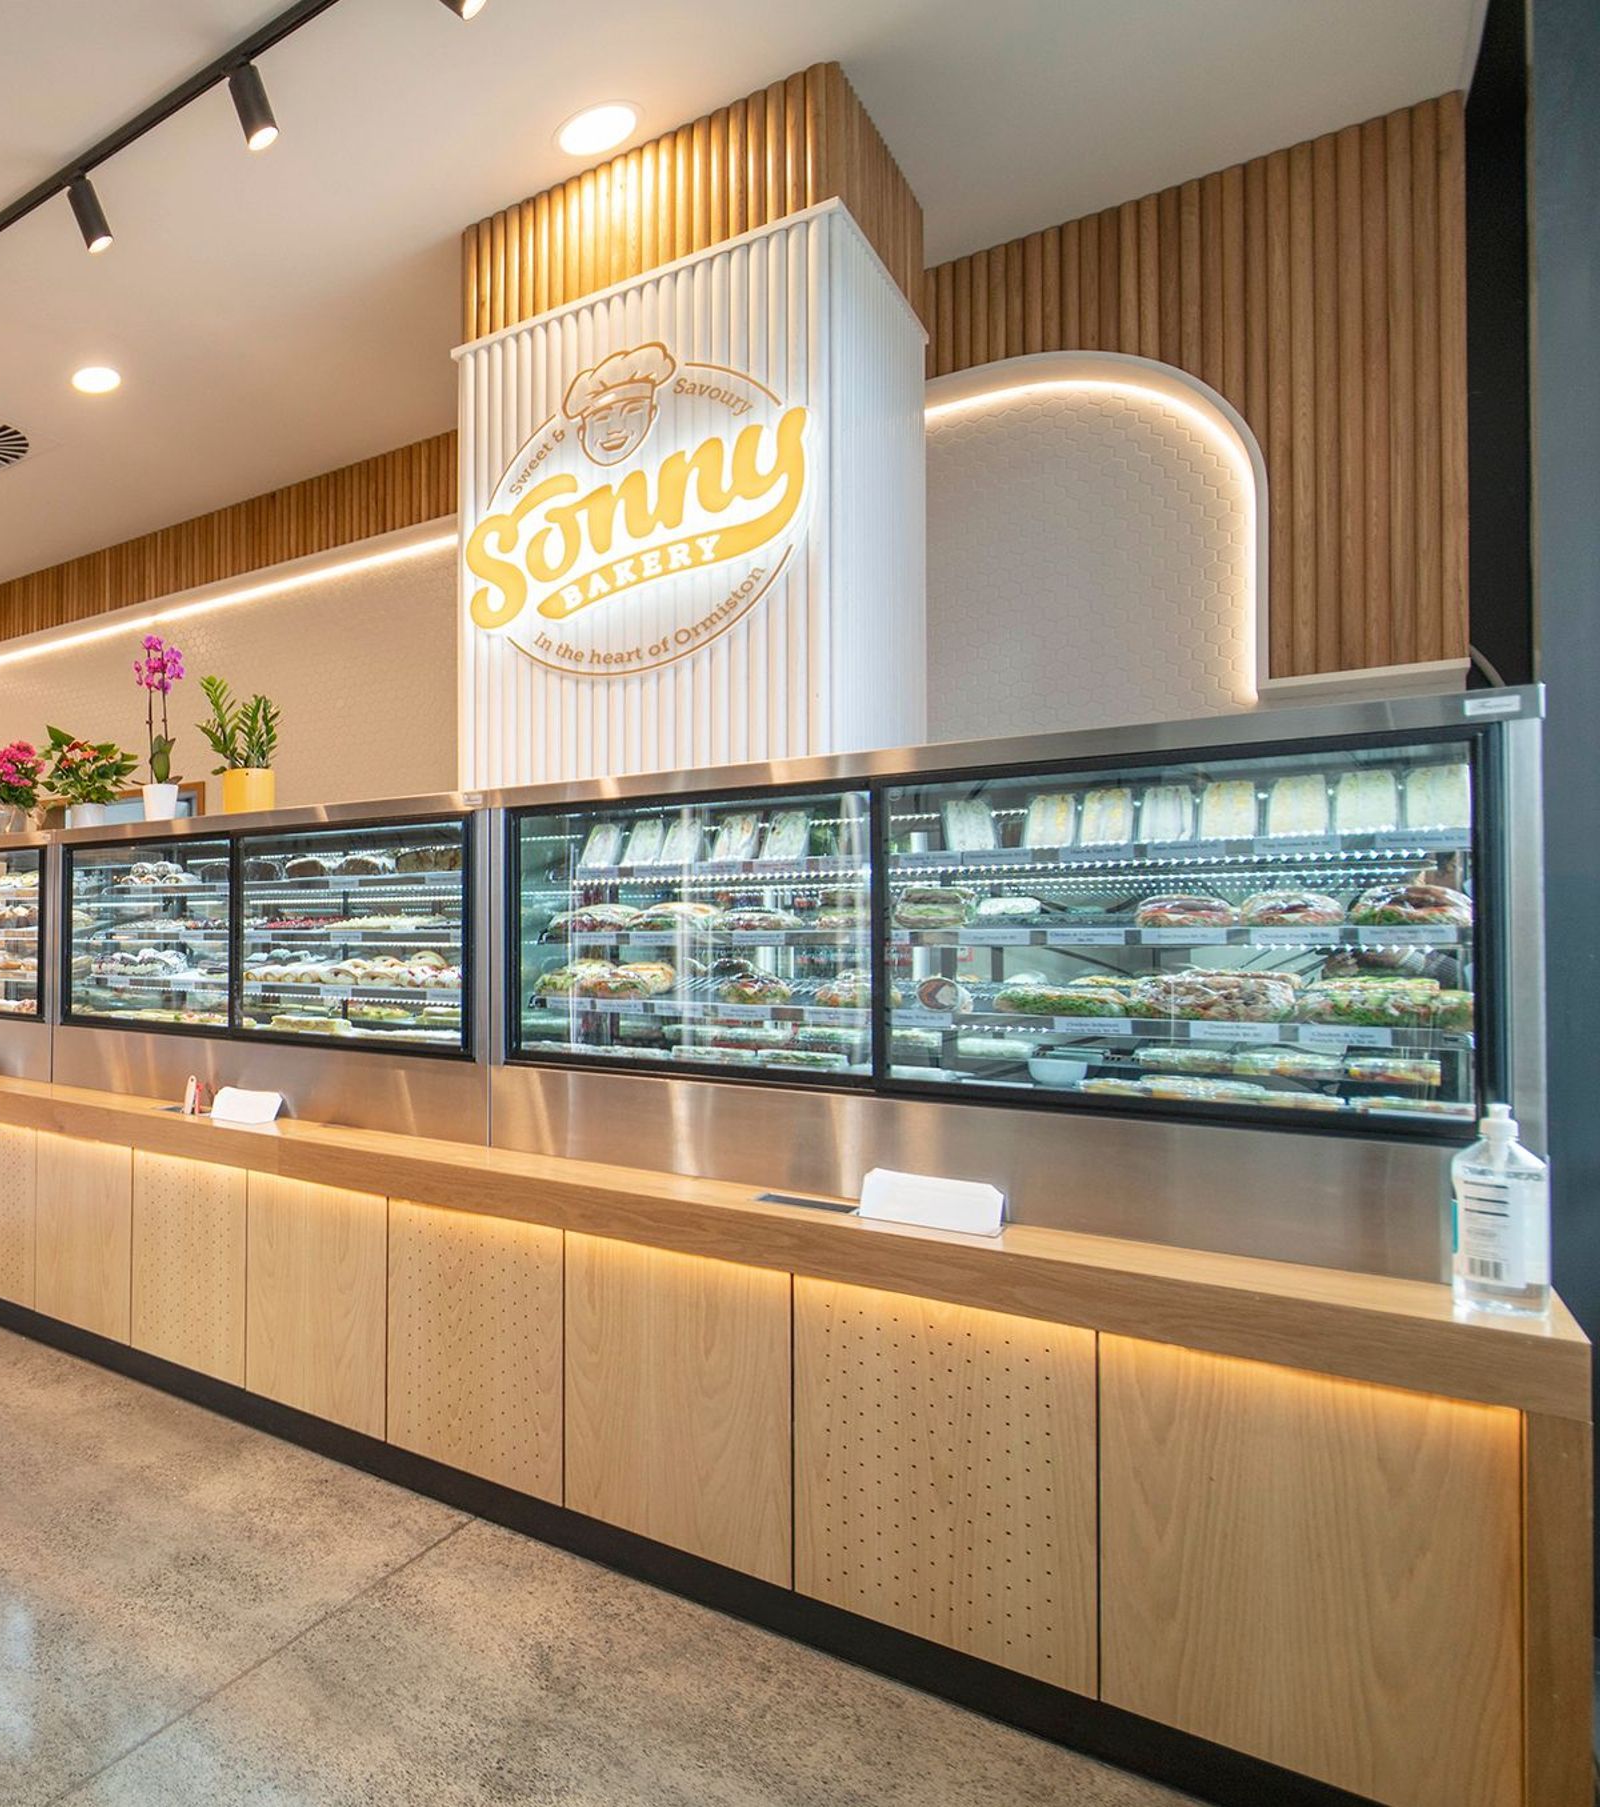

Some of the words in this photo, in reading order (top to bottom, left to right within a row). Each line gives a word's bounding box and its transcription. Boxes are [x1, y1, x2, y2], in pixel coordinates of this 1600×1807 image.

[509, 444, 553, 496] Sweet
[552, 430, 566, 444] &
[673, 377, 753, 416] Savoury
[466, 406, 808, 629] Sonny
[560, 534, 722, 609] BAKERY
[533, 631, 552, 651] In
[556, 640, 585, 664] the
[588, 641, 645, 665] heart
[648, 635, 671, 658] of
[674, 564, 767, 646] Ormiston
